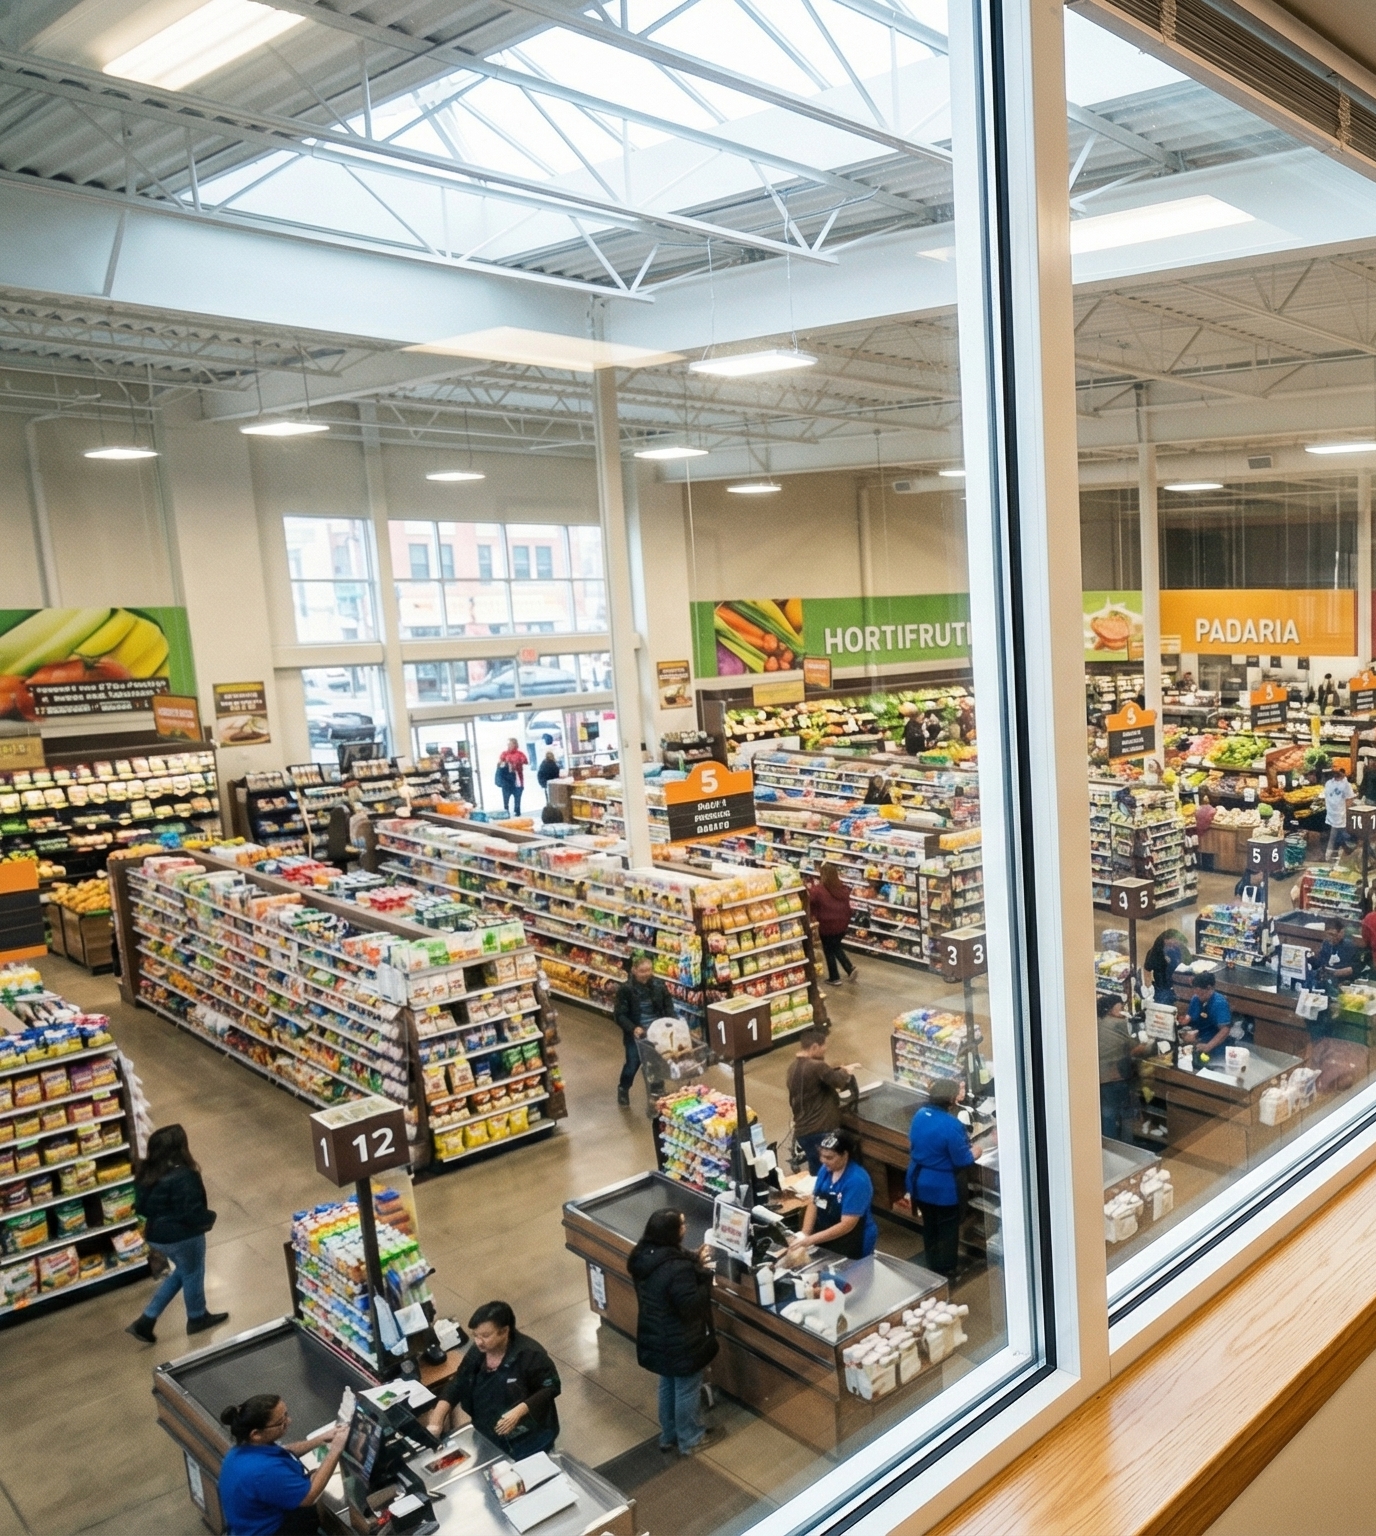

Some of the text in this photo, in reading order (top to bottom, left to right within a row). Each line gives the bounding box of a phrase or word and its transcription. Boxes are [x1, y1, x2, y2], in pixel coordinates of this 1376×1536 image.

[824, 621, 972, 655] HORTIFRUTI
[1195, 618, 1300, 644] PADARIA
[701, 768, 719, 794] 5
[1370, 814, 1376, 830] 1
[1252, 847, 1261, 864] 5
[1271, 847, 1279, 863] 6
[947, 945, 957, 966] 3
[972, 943, 984, 965] 3
[717, 1020, 726, 1045] 1
[747, 1017, 758, 1041] 1
[320, 1137, 330, 1168] 1
[352, 1127, 396, 1163] 12
